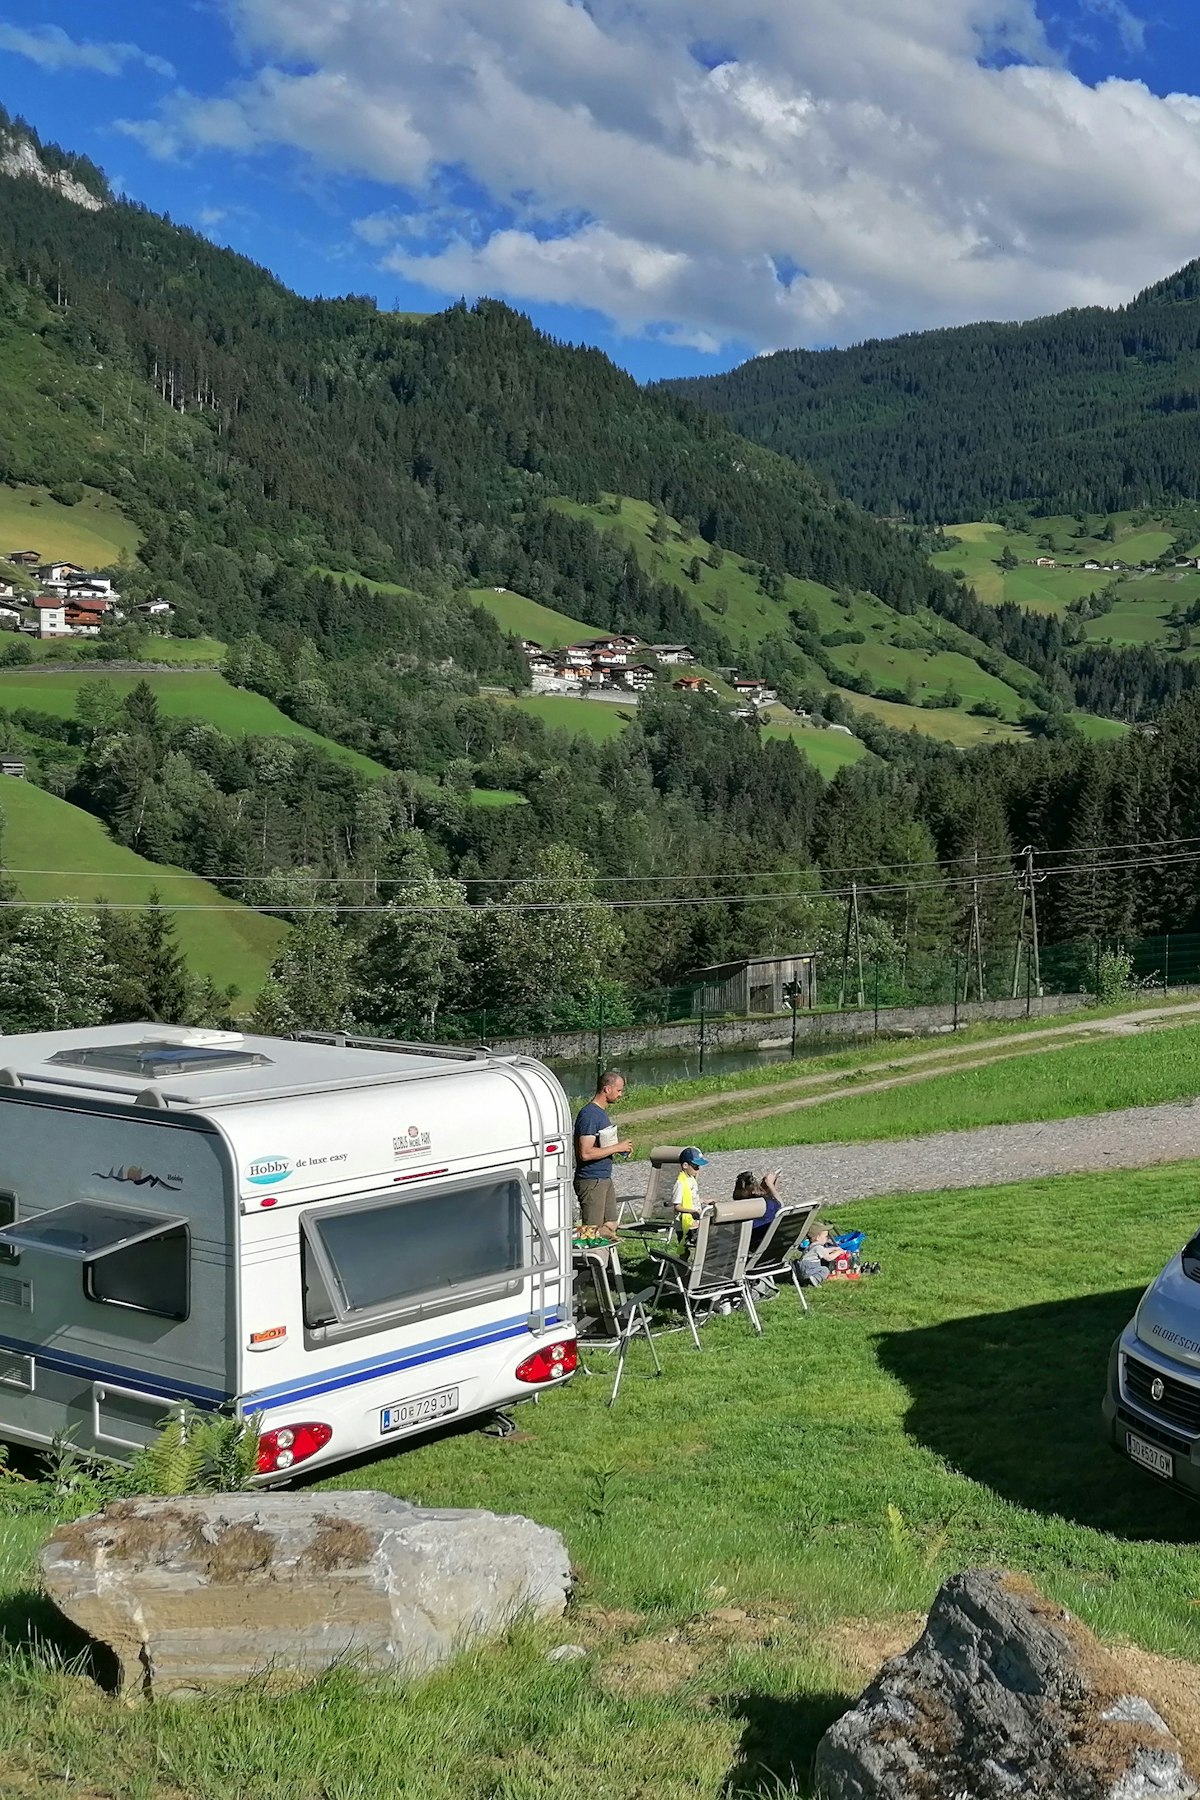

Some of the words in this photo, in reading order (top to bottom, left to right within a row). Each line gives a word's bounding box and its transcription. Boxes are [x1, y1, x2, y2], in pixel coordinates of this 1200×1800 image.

[250, 1161, 290, 1176] Hobby
[296, 1160, 307, 1168] de
[309, 1157, 327, 1165] luxe
[329, 1153, 348, 1161] easy
